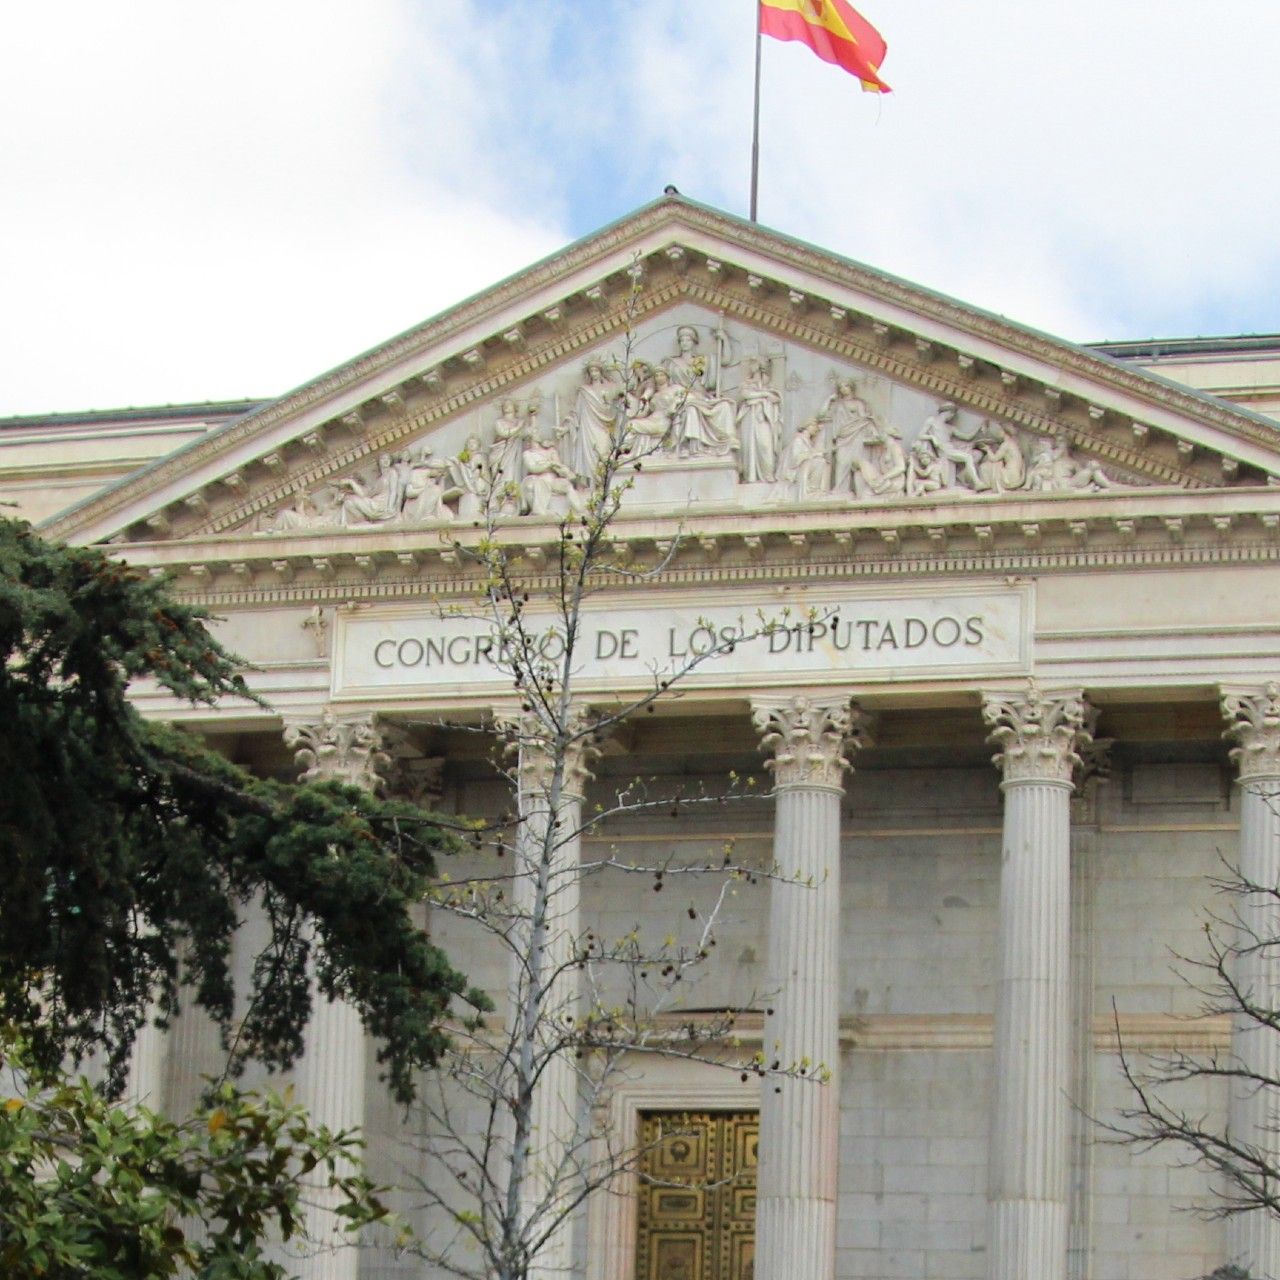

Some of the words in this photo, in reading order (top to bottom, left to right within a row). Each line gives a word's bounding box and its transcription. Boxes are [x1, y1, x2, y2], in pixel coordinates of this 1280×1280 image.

[595, 629, 640, 660] DE
[668, 626, 736, 657] LOS
[768, 616, 985, 655] DIPUTADOS
